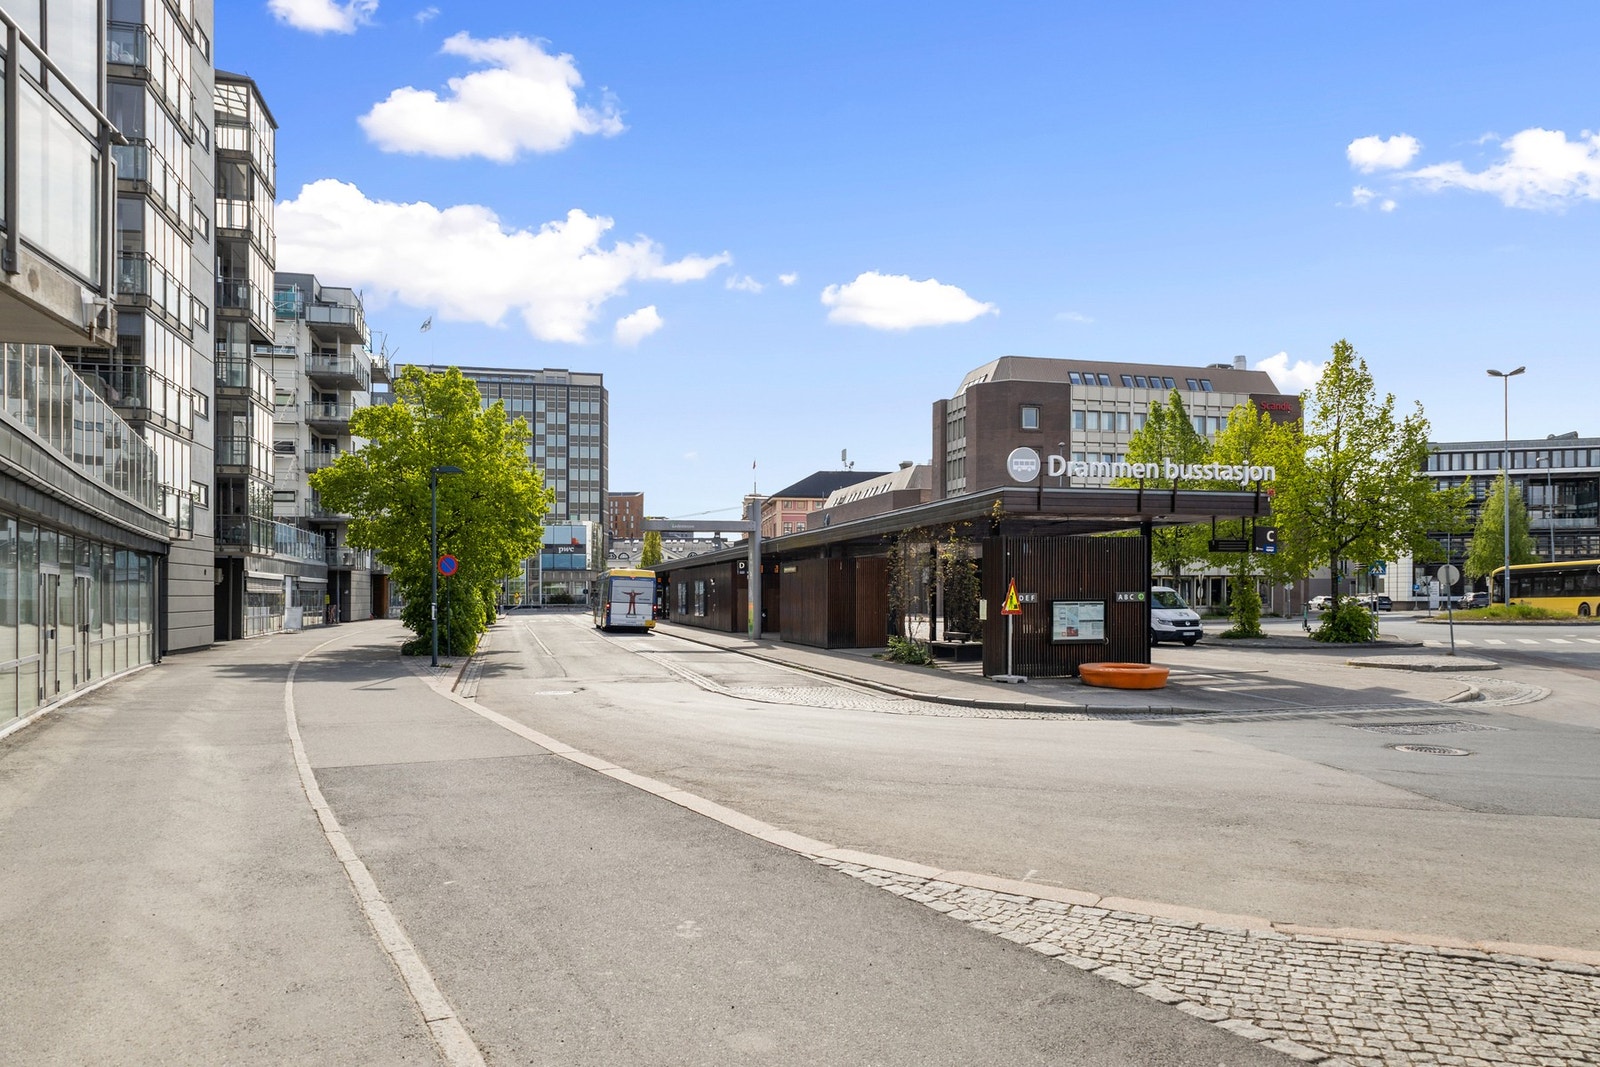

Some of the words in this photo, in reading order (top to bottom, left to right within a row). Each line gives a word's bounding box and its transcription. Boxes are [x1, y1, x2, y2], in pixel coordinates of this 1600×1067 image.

[1261, 401, 1292, 411] Scandic
[1048, 454, 1159, 479] Drammen
[1164, 457, 1276, 486] busstasjon
[1266, 530, 1274, 541] C
[558, 546, 575, 554] pwc
